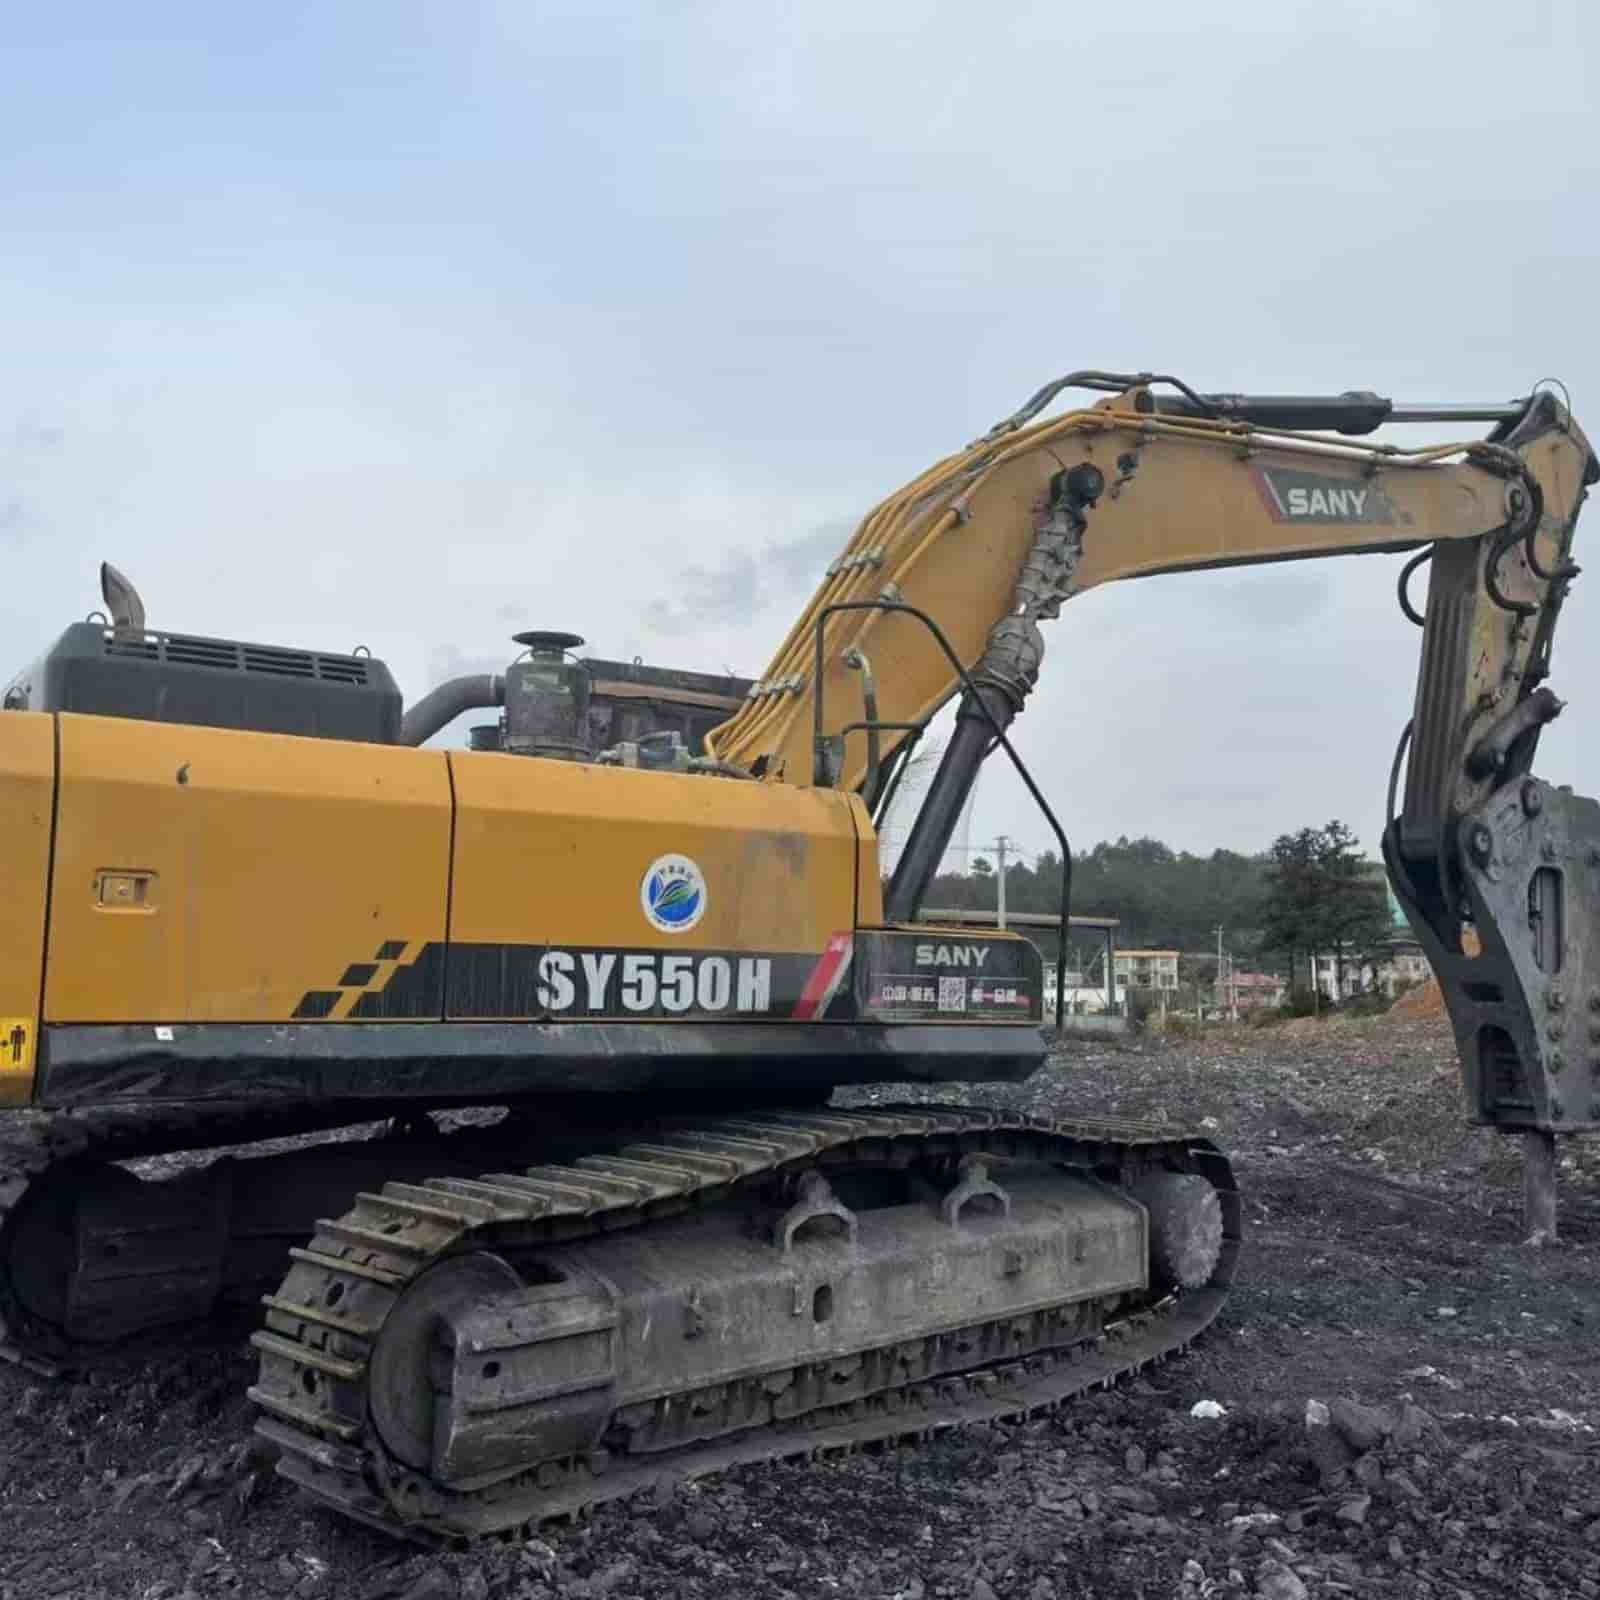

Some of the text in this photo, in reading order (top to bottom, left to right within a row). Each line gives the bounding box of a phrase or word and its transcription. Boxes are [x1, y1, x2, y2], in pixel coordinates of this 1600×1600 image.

[1287, 488, 1367, 515] SANY
[915, 944, 989, 967] SANY
[537, 951, 771, 1012] SY550H
